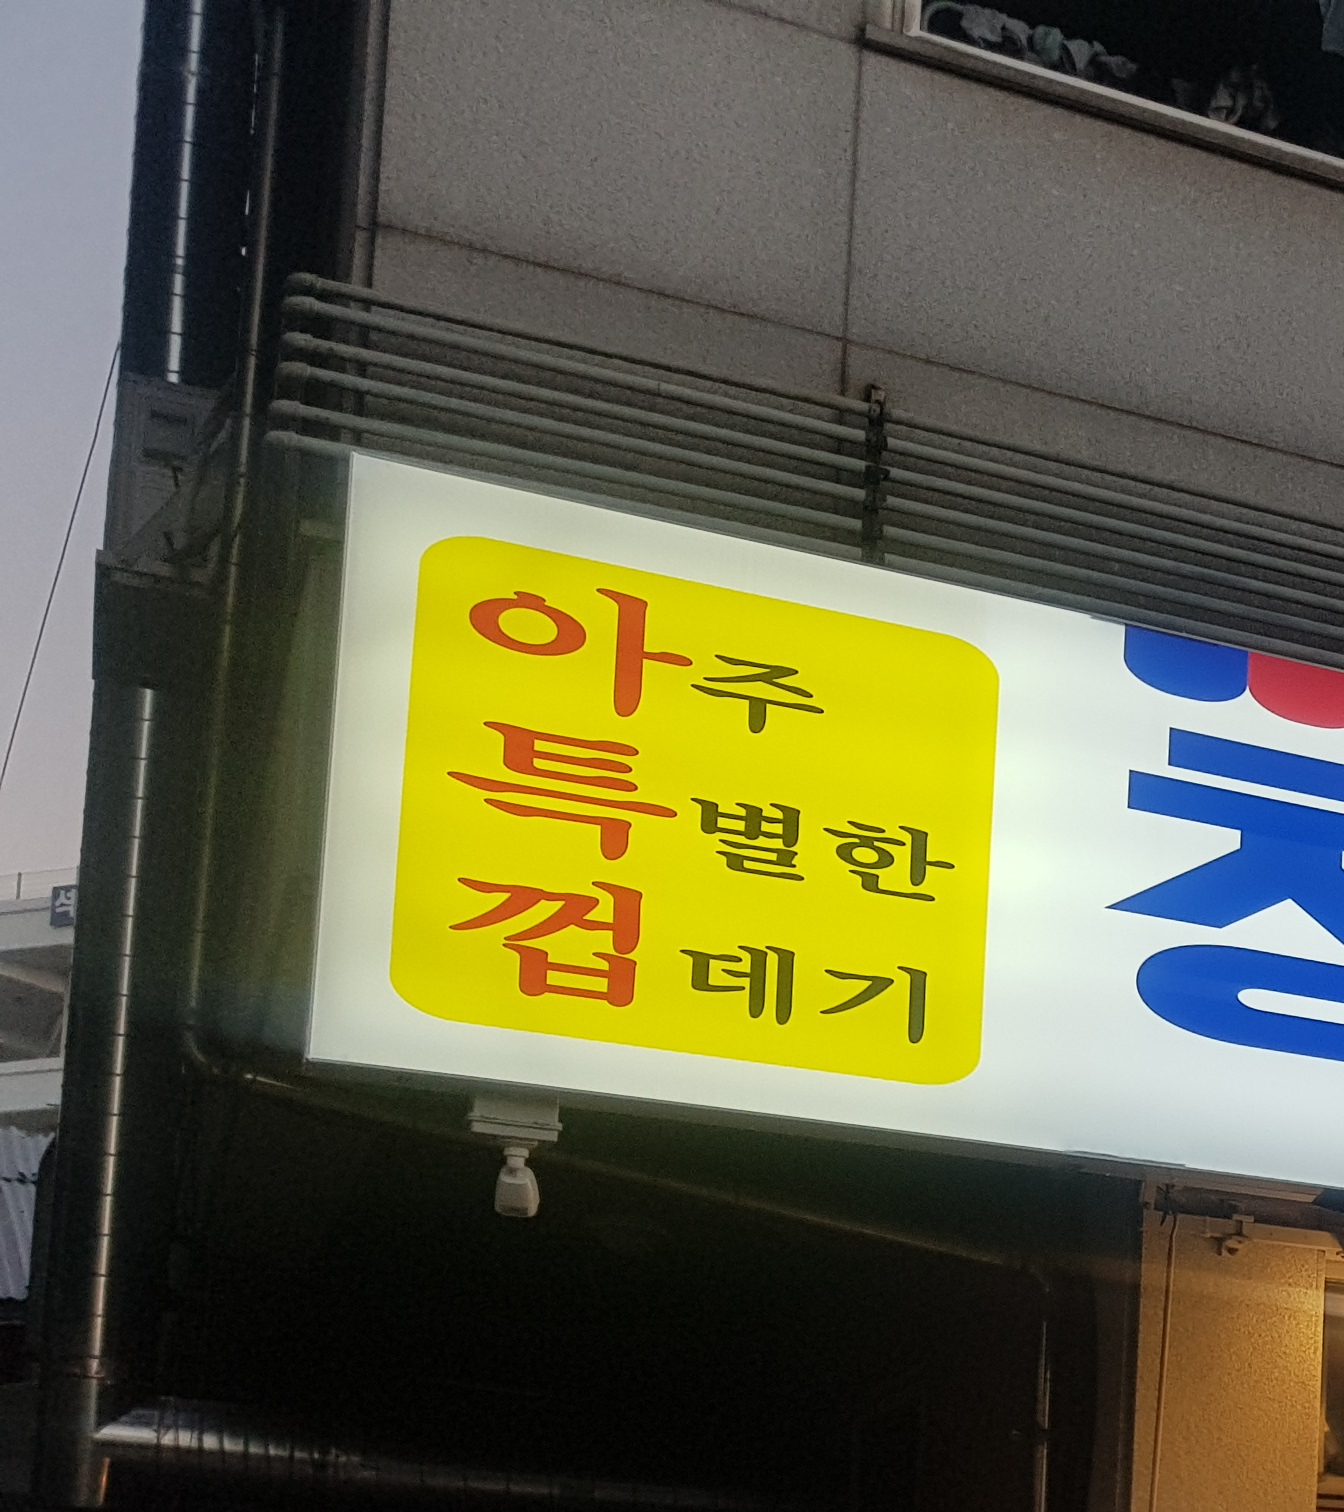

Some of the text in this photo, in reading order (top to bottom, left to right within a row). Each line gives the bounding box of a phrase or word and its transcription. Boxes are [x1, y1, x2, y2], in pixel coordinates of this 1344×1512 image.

[469, 588, 824, 734] 아주
[447, 721, 955, 902] 특별한
[449, 877, 928, 1044] 껍데기
